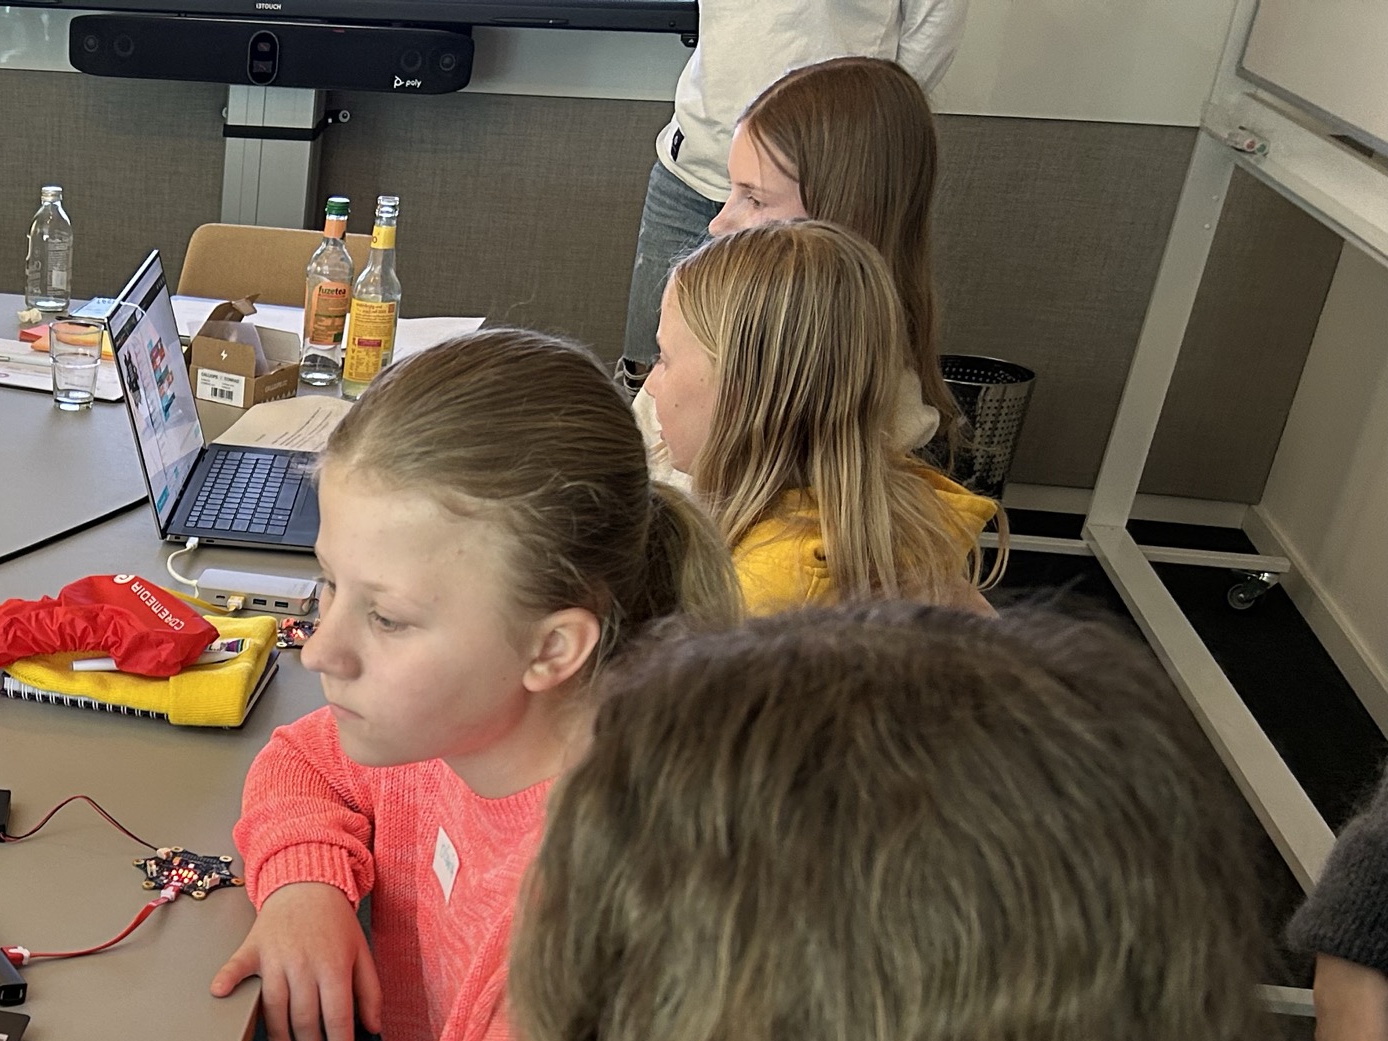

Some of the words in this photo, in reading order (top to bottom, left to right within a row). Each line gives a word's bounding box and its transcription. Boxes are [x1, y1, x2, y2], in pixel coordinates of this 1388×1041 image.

[405, 79, 422, 88] poly
[318, 285, 347, 296] fuzetea
[130, 581, 185, 631] COREMEDIA
